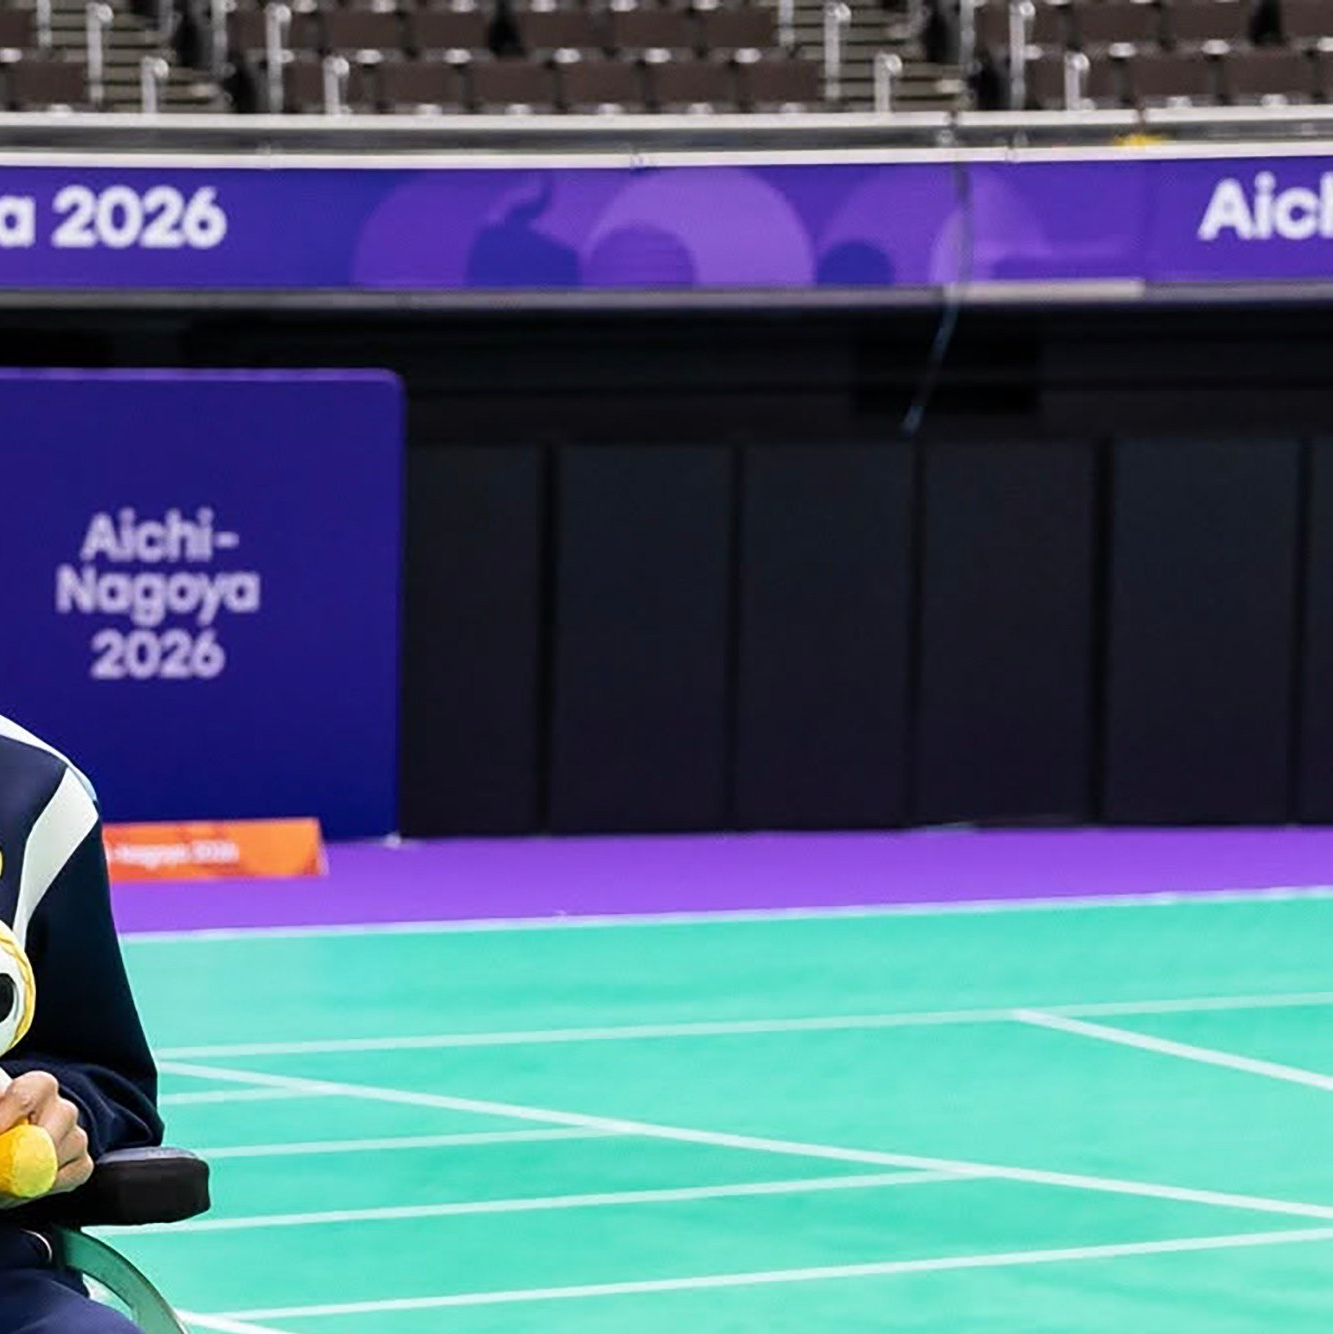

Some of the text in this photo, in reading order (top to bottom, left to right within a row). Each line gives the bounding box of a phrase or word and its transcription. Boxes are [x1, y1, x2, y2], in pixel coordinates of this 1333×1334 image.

[50, 184, 228, 249] 2026
[80, 507, 239, 562] Aichi-
[56, 563, 261, 627] Nagoya
[91, 627, 226, 680] 2026
